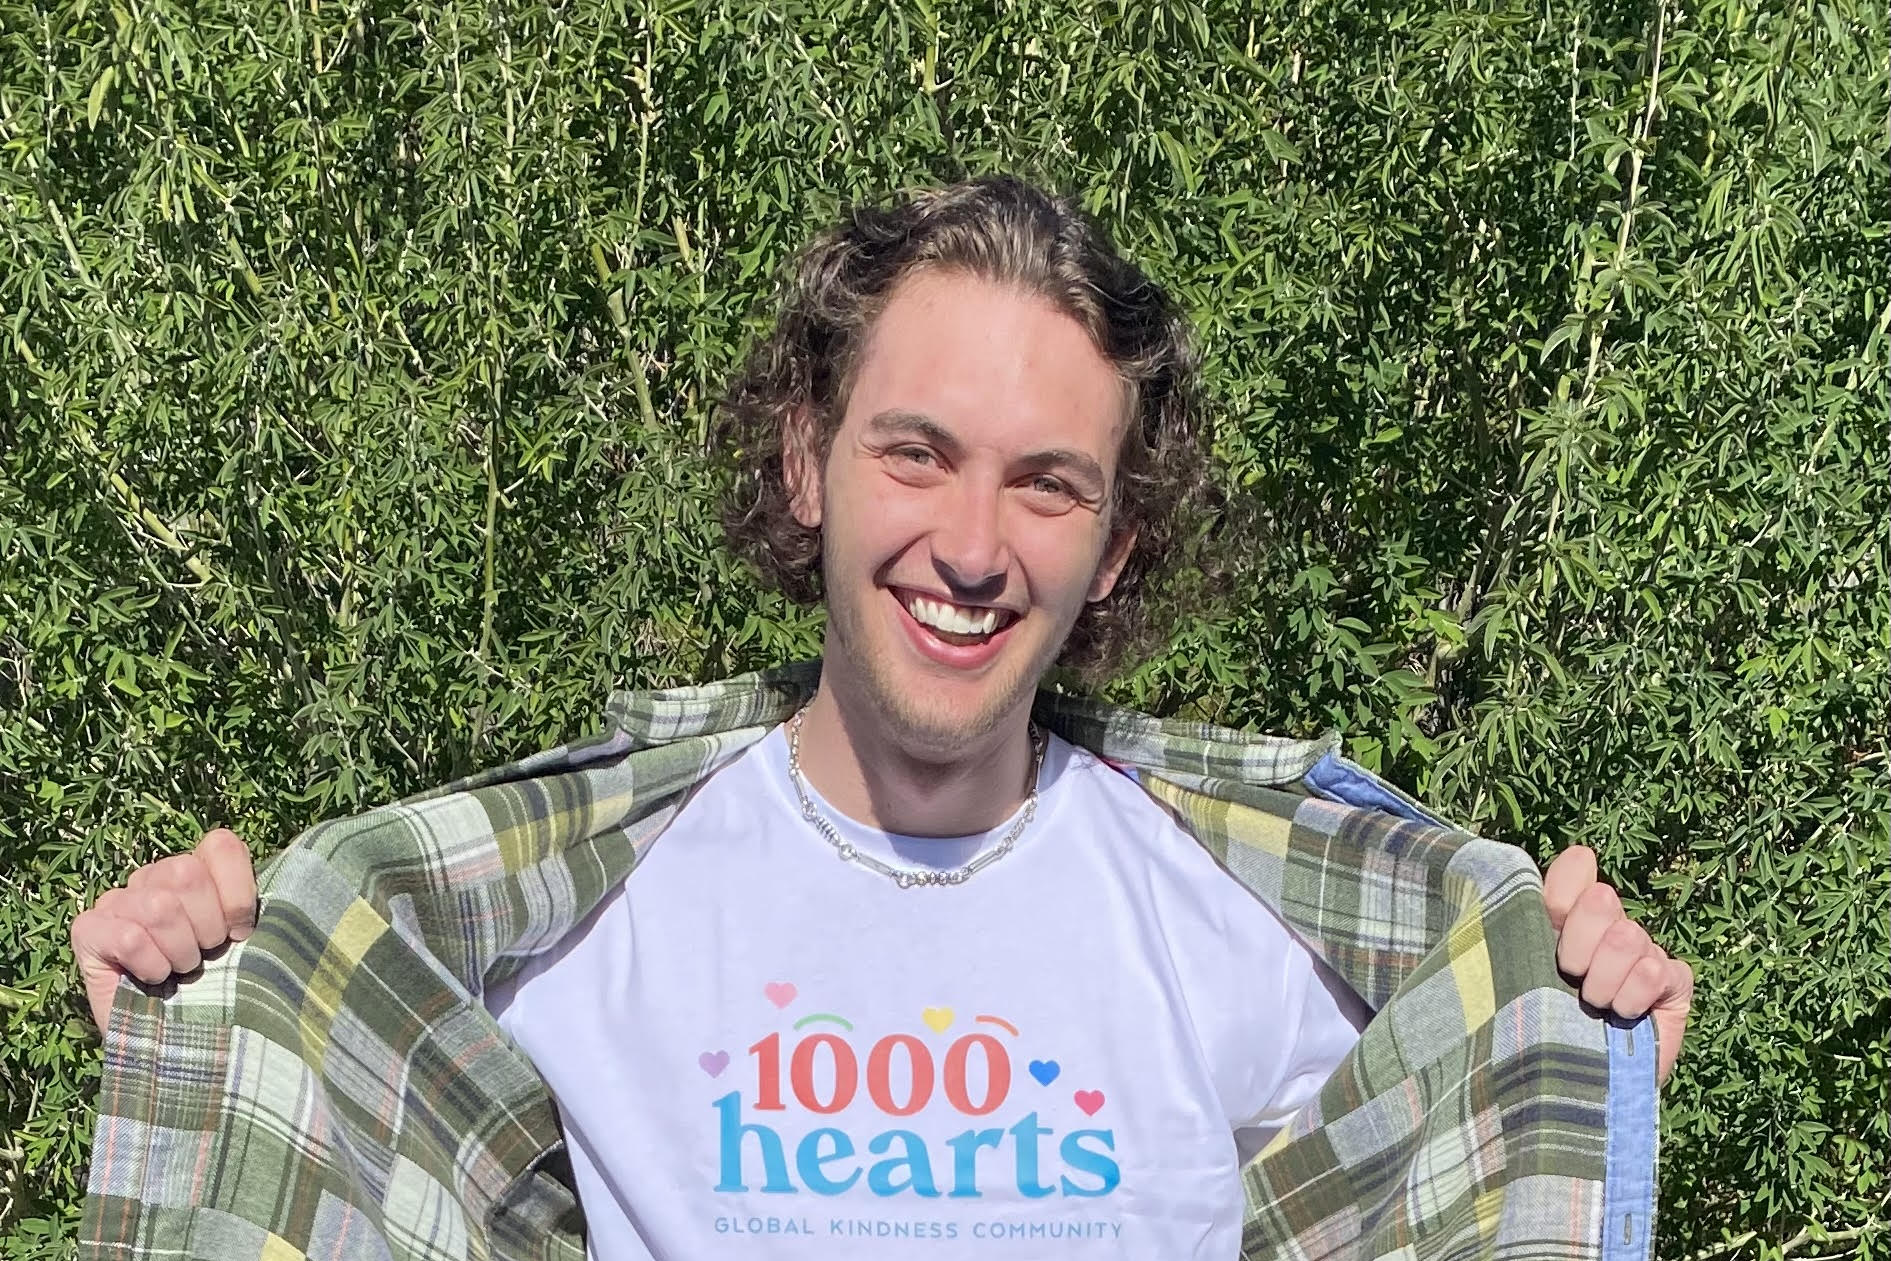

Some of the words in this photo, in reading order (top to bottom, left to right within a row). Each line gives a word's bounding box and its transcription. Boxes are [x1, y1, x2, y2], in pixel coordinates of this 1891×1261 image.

[748, 1031, 1012, 1117] 1000
[712, 1090, 1121, 1199] hearts
[714, 1216, 815, 1236] GLOBAL
[830, 1218, 959, 1239] KINDNESS
[972, 1221, 1122, 1240] COMMUNITY
